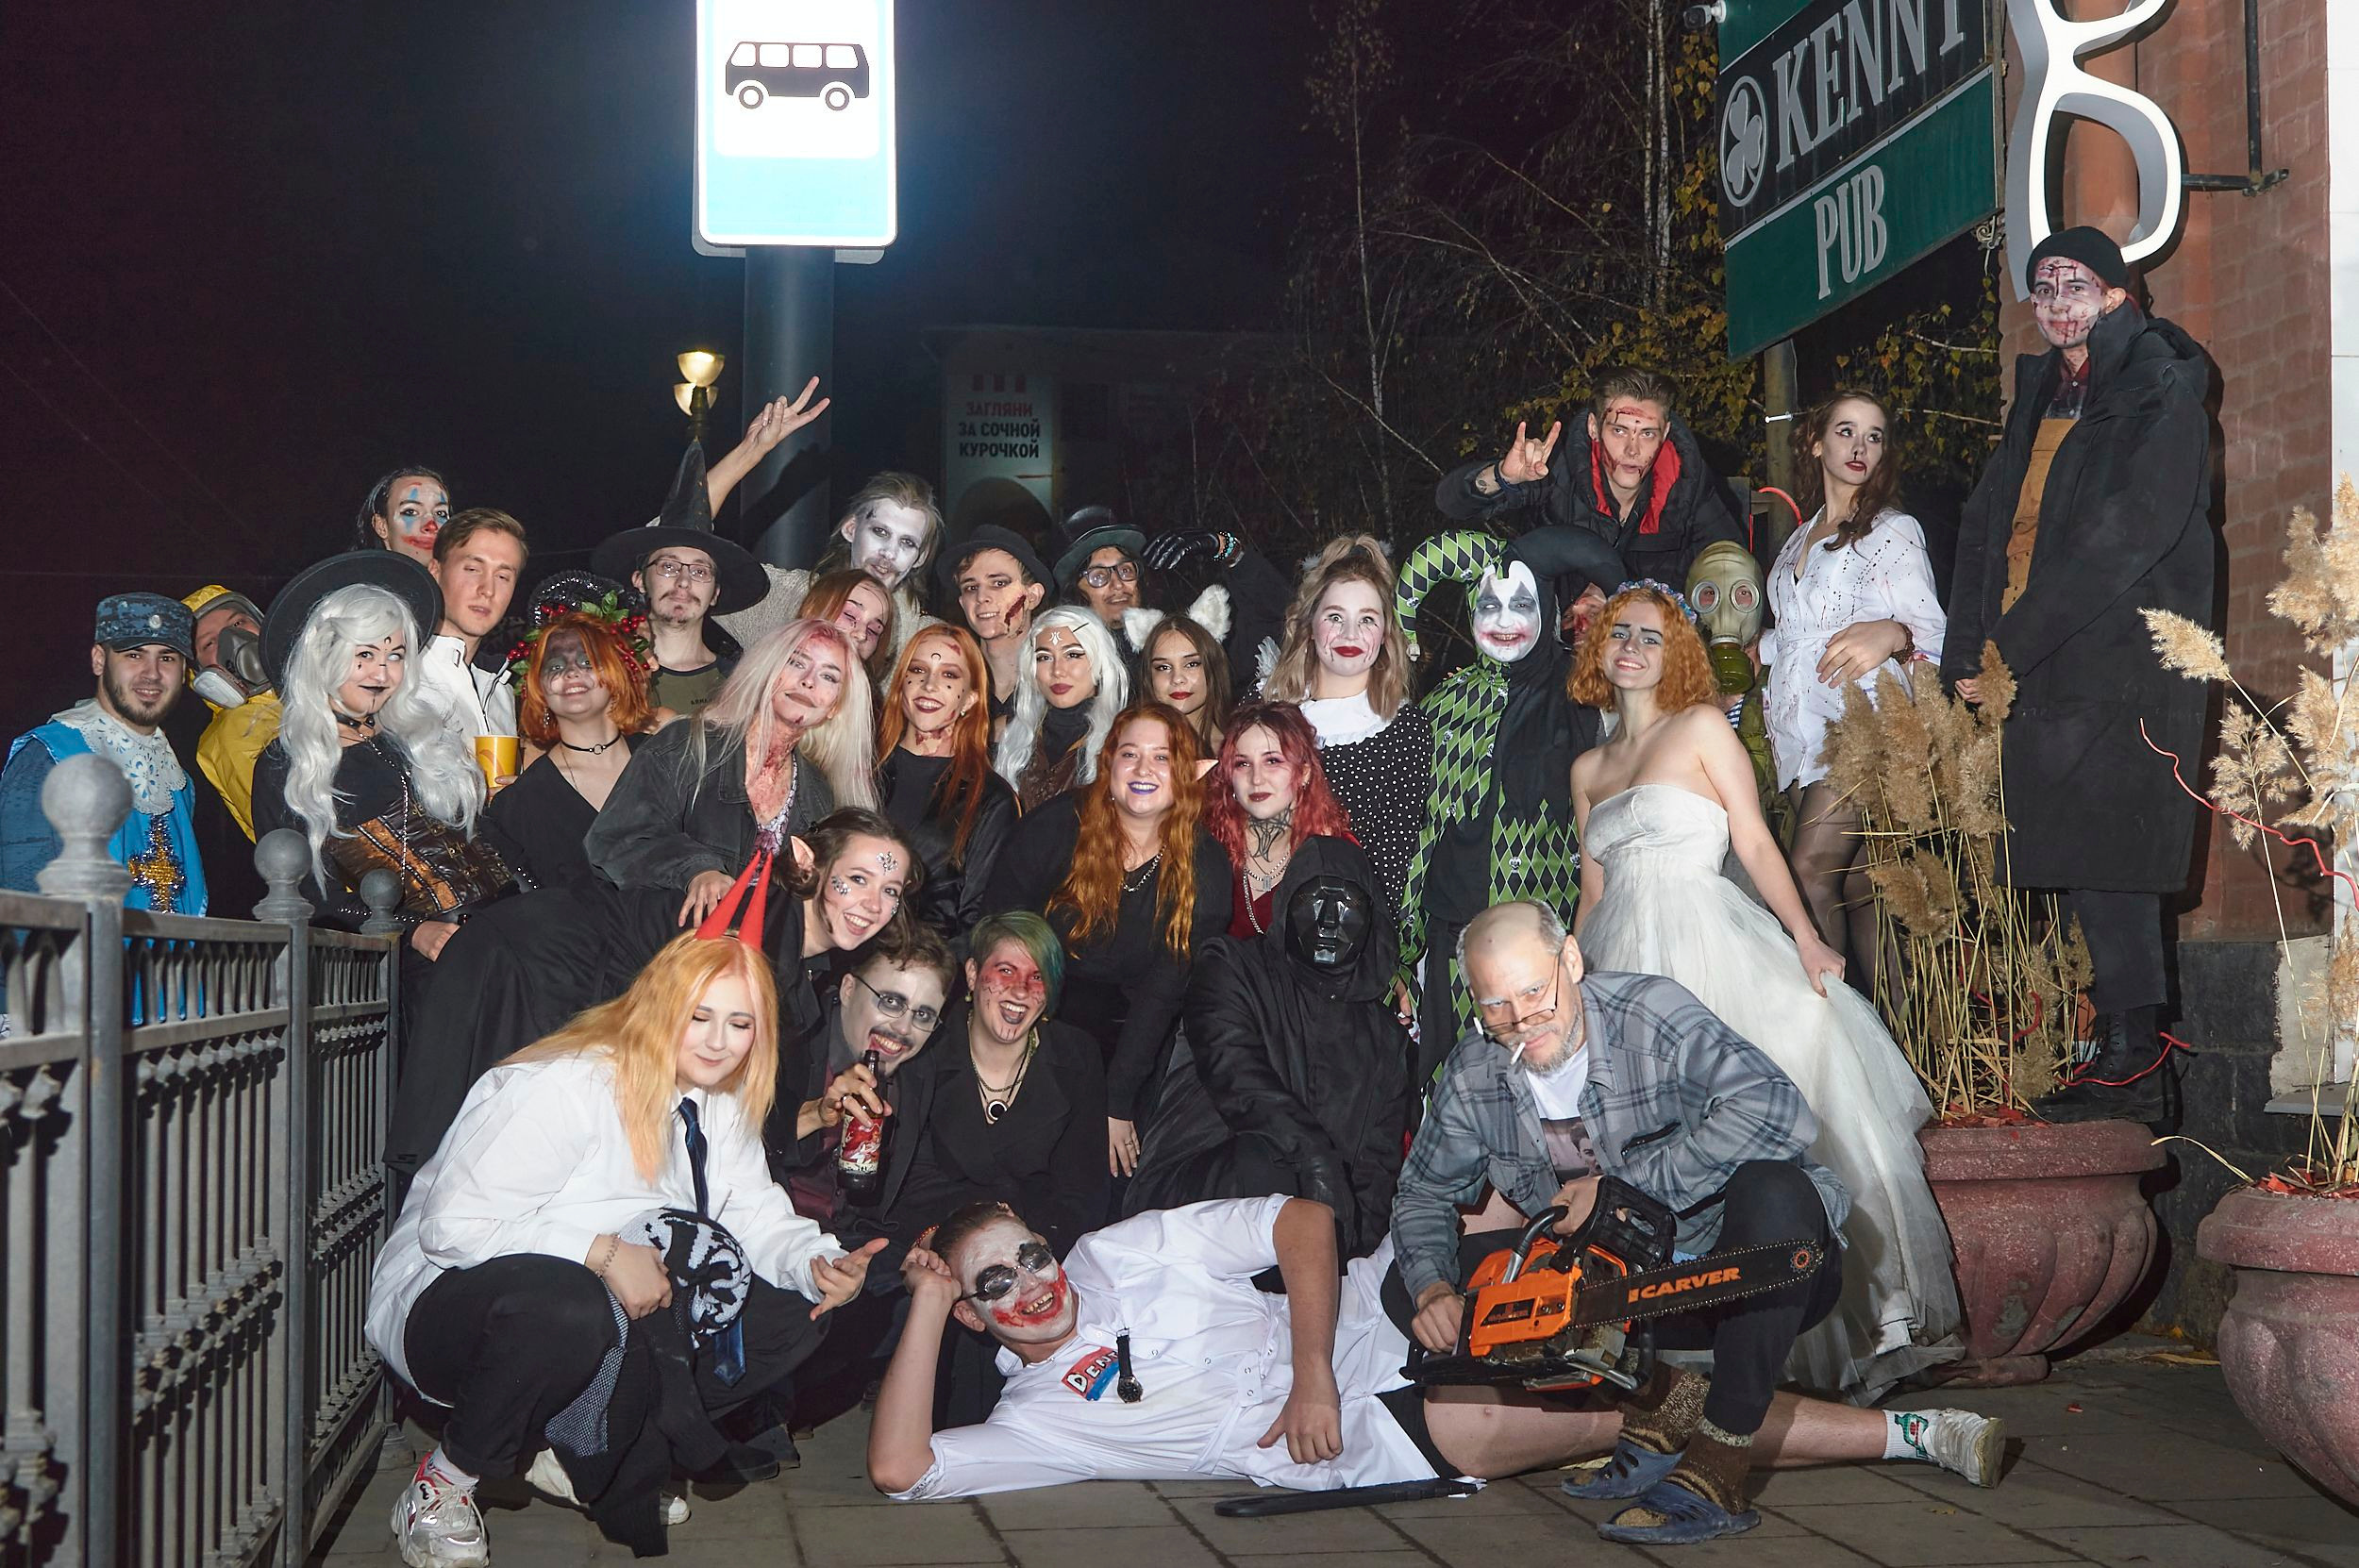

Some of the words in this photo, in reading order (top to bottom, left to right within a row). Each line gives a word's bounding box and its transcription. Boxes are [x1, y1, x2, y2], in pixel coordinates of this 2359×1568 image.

[1814, 164, 1887, 300] PUB
[965, 401, 1033, 417] ЗАГЛЯНИ
[958, 423, 977, 437] ЗА
[980, 418, 1041, 438] СОЧНОЙ
[959, 440, 1039, 459] КУРОЧКОЙ
[1641, 1267, 1742, 1299] CARVER
